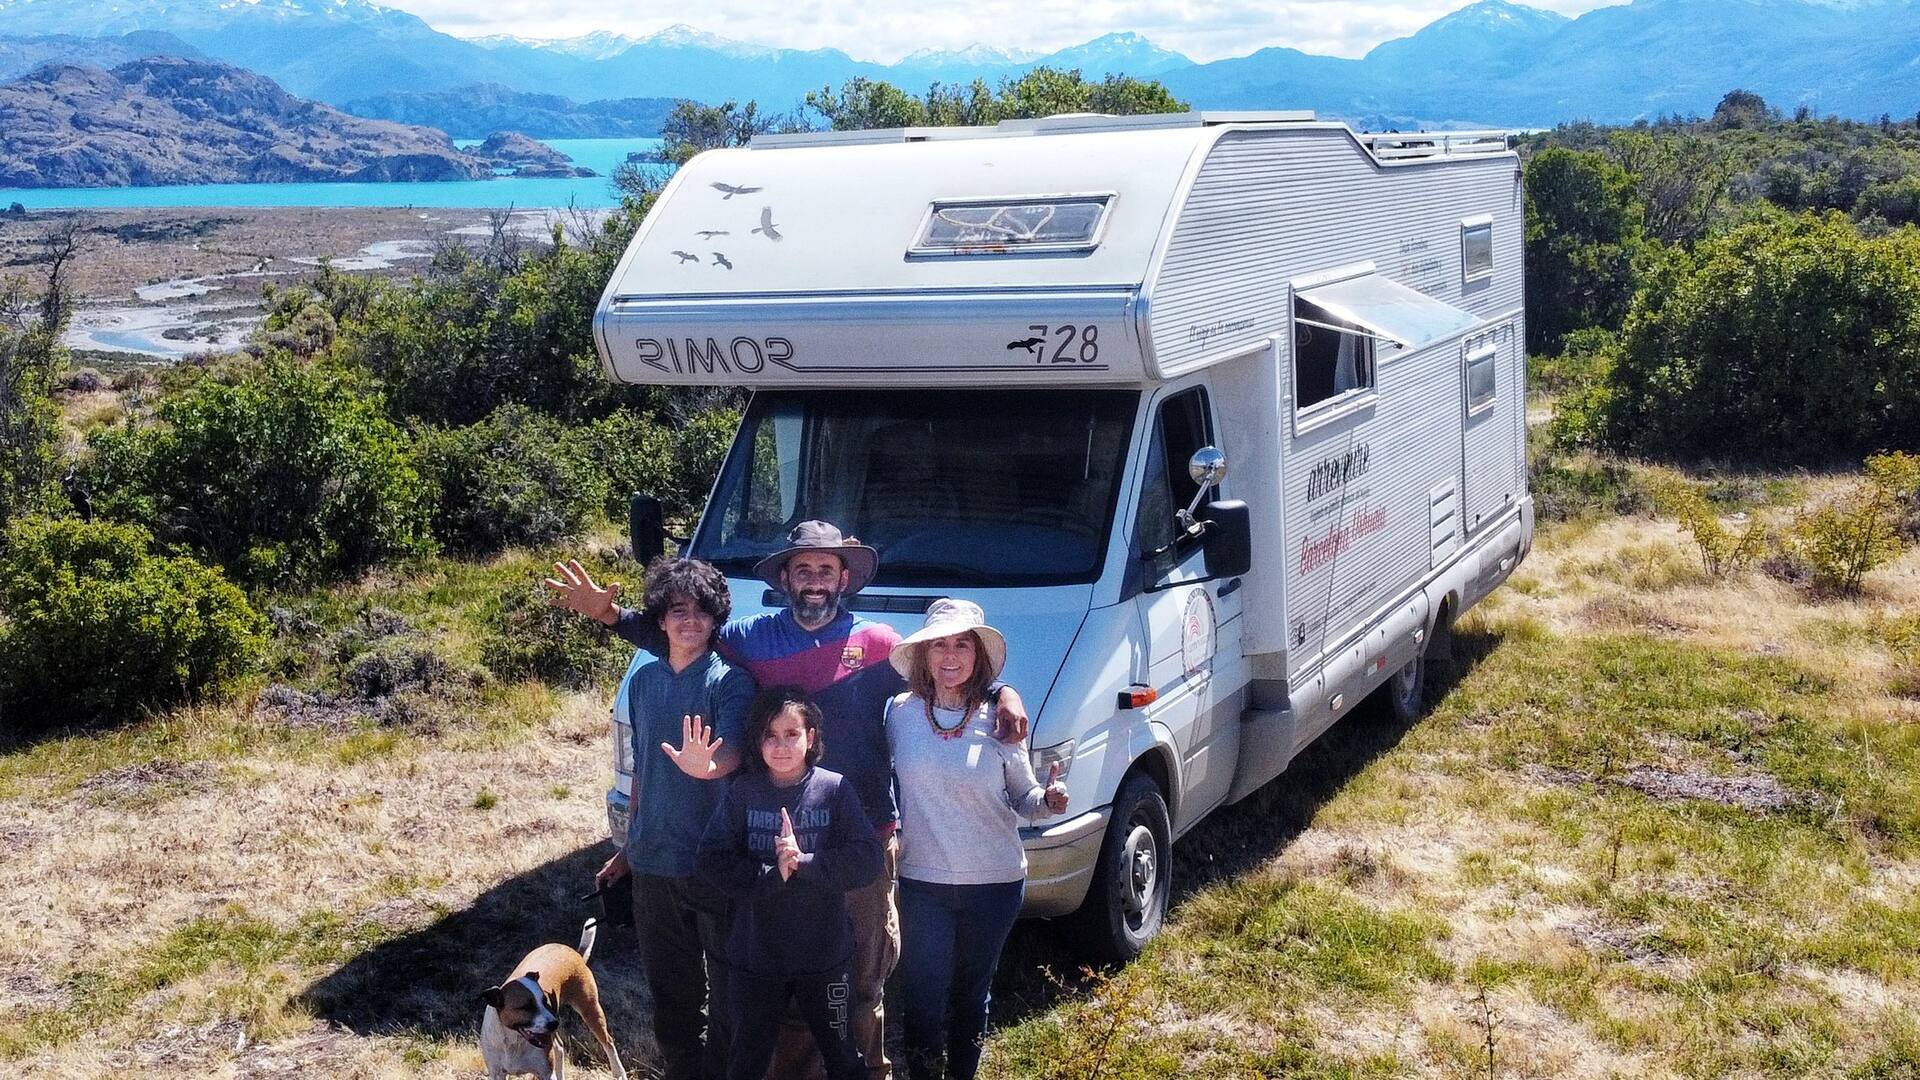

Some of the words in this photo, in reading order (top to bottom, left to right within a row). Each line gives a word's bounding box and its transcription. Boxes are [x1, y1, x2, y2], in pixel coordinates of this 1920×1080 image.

[635, 336, 797, 375] RIMOR
[1028, 324, 1100, 365] 728
[747, 807, 831, 830] IMBELAND
[748, 832, 818, 851] COMNY
